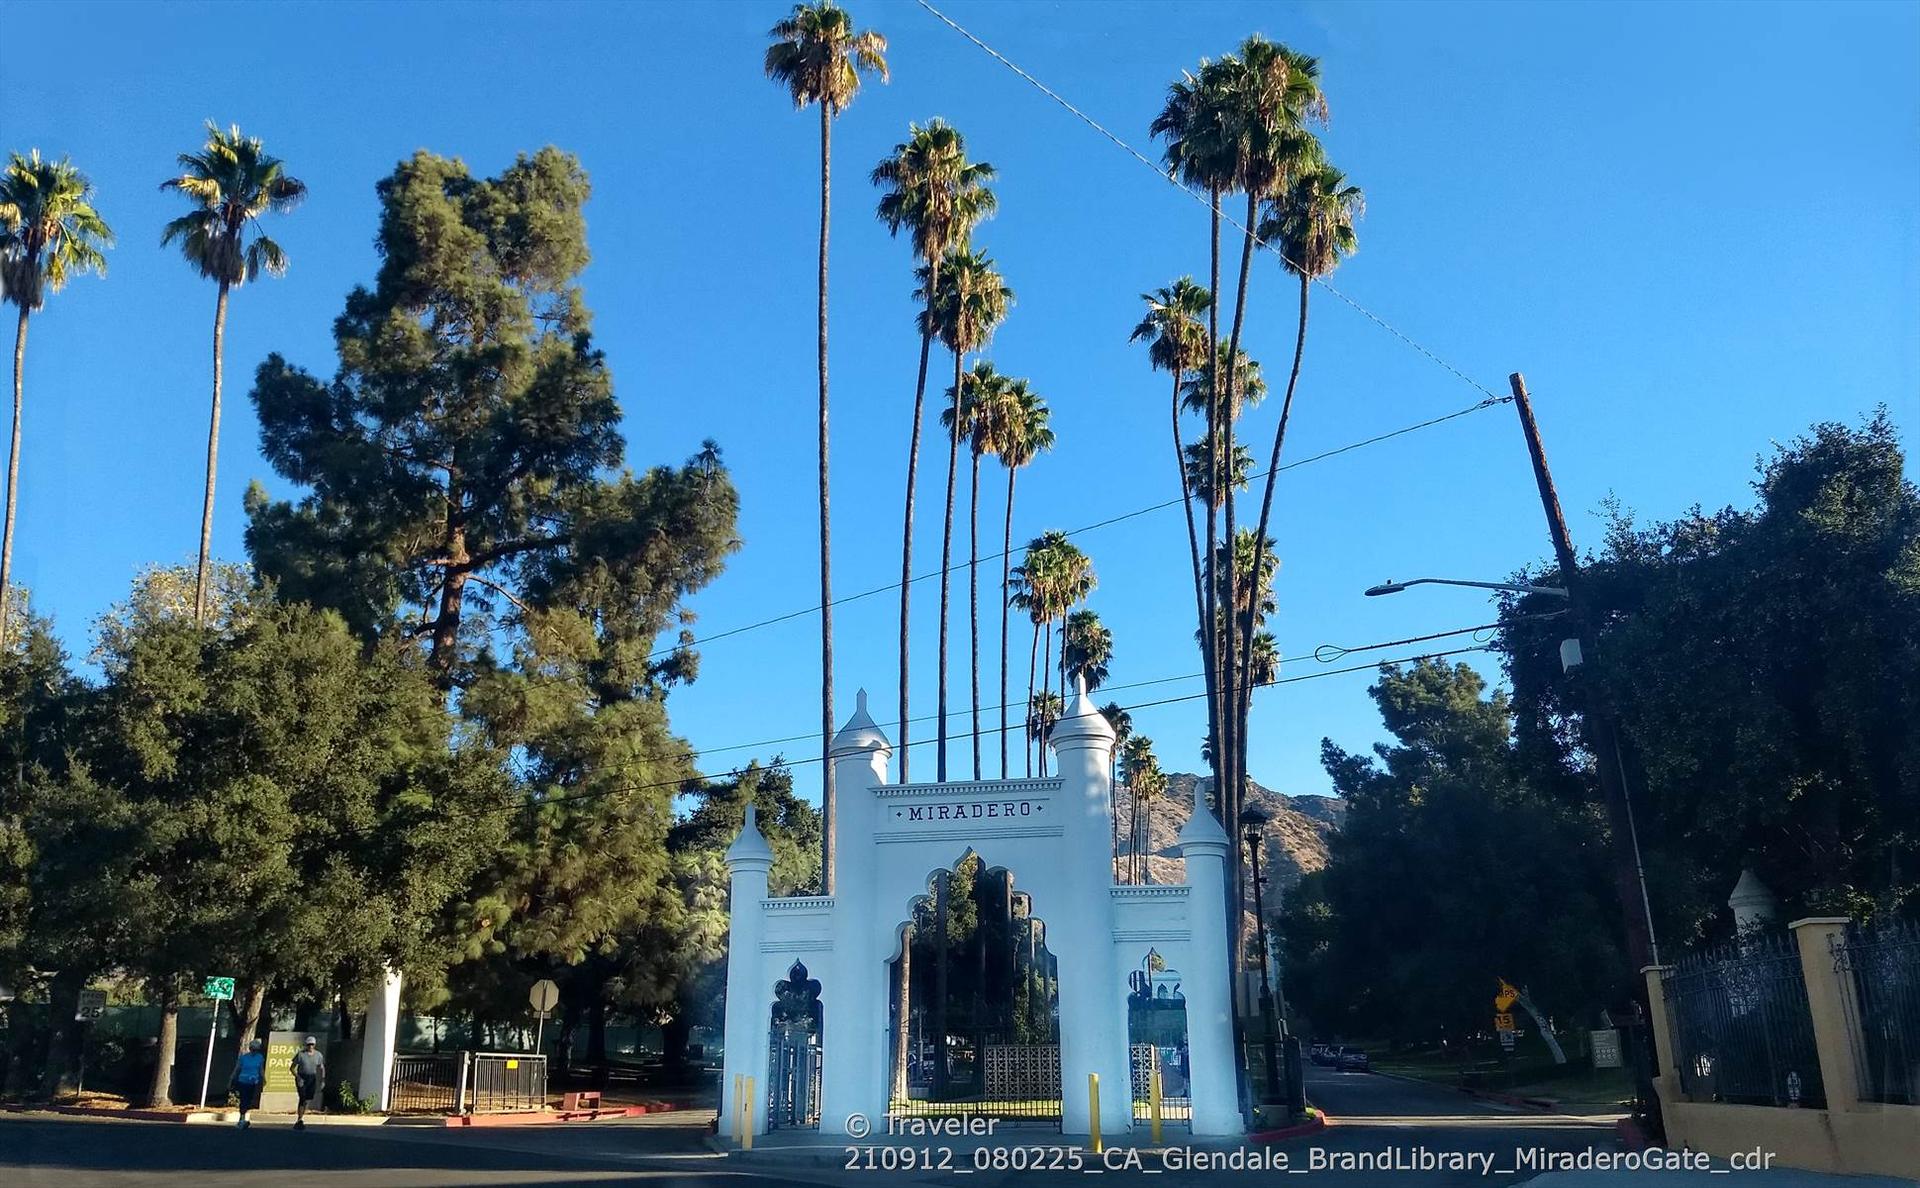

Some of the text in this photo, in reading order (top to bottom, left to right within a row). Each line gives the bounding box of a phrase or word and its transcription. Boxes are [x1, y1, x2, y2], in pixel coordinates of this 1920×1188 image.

[909, 802, 1030, 821] MIRADERO
[81, 1006, 100, 1018] 25
[1498, 1015, 1511, 1024] 15
[270, 1044, 302, 1055] BRAN
[269, 1058, 292, 1068] PAR
